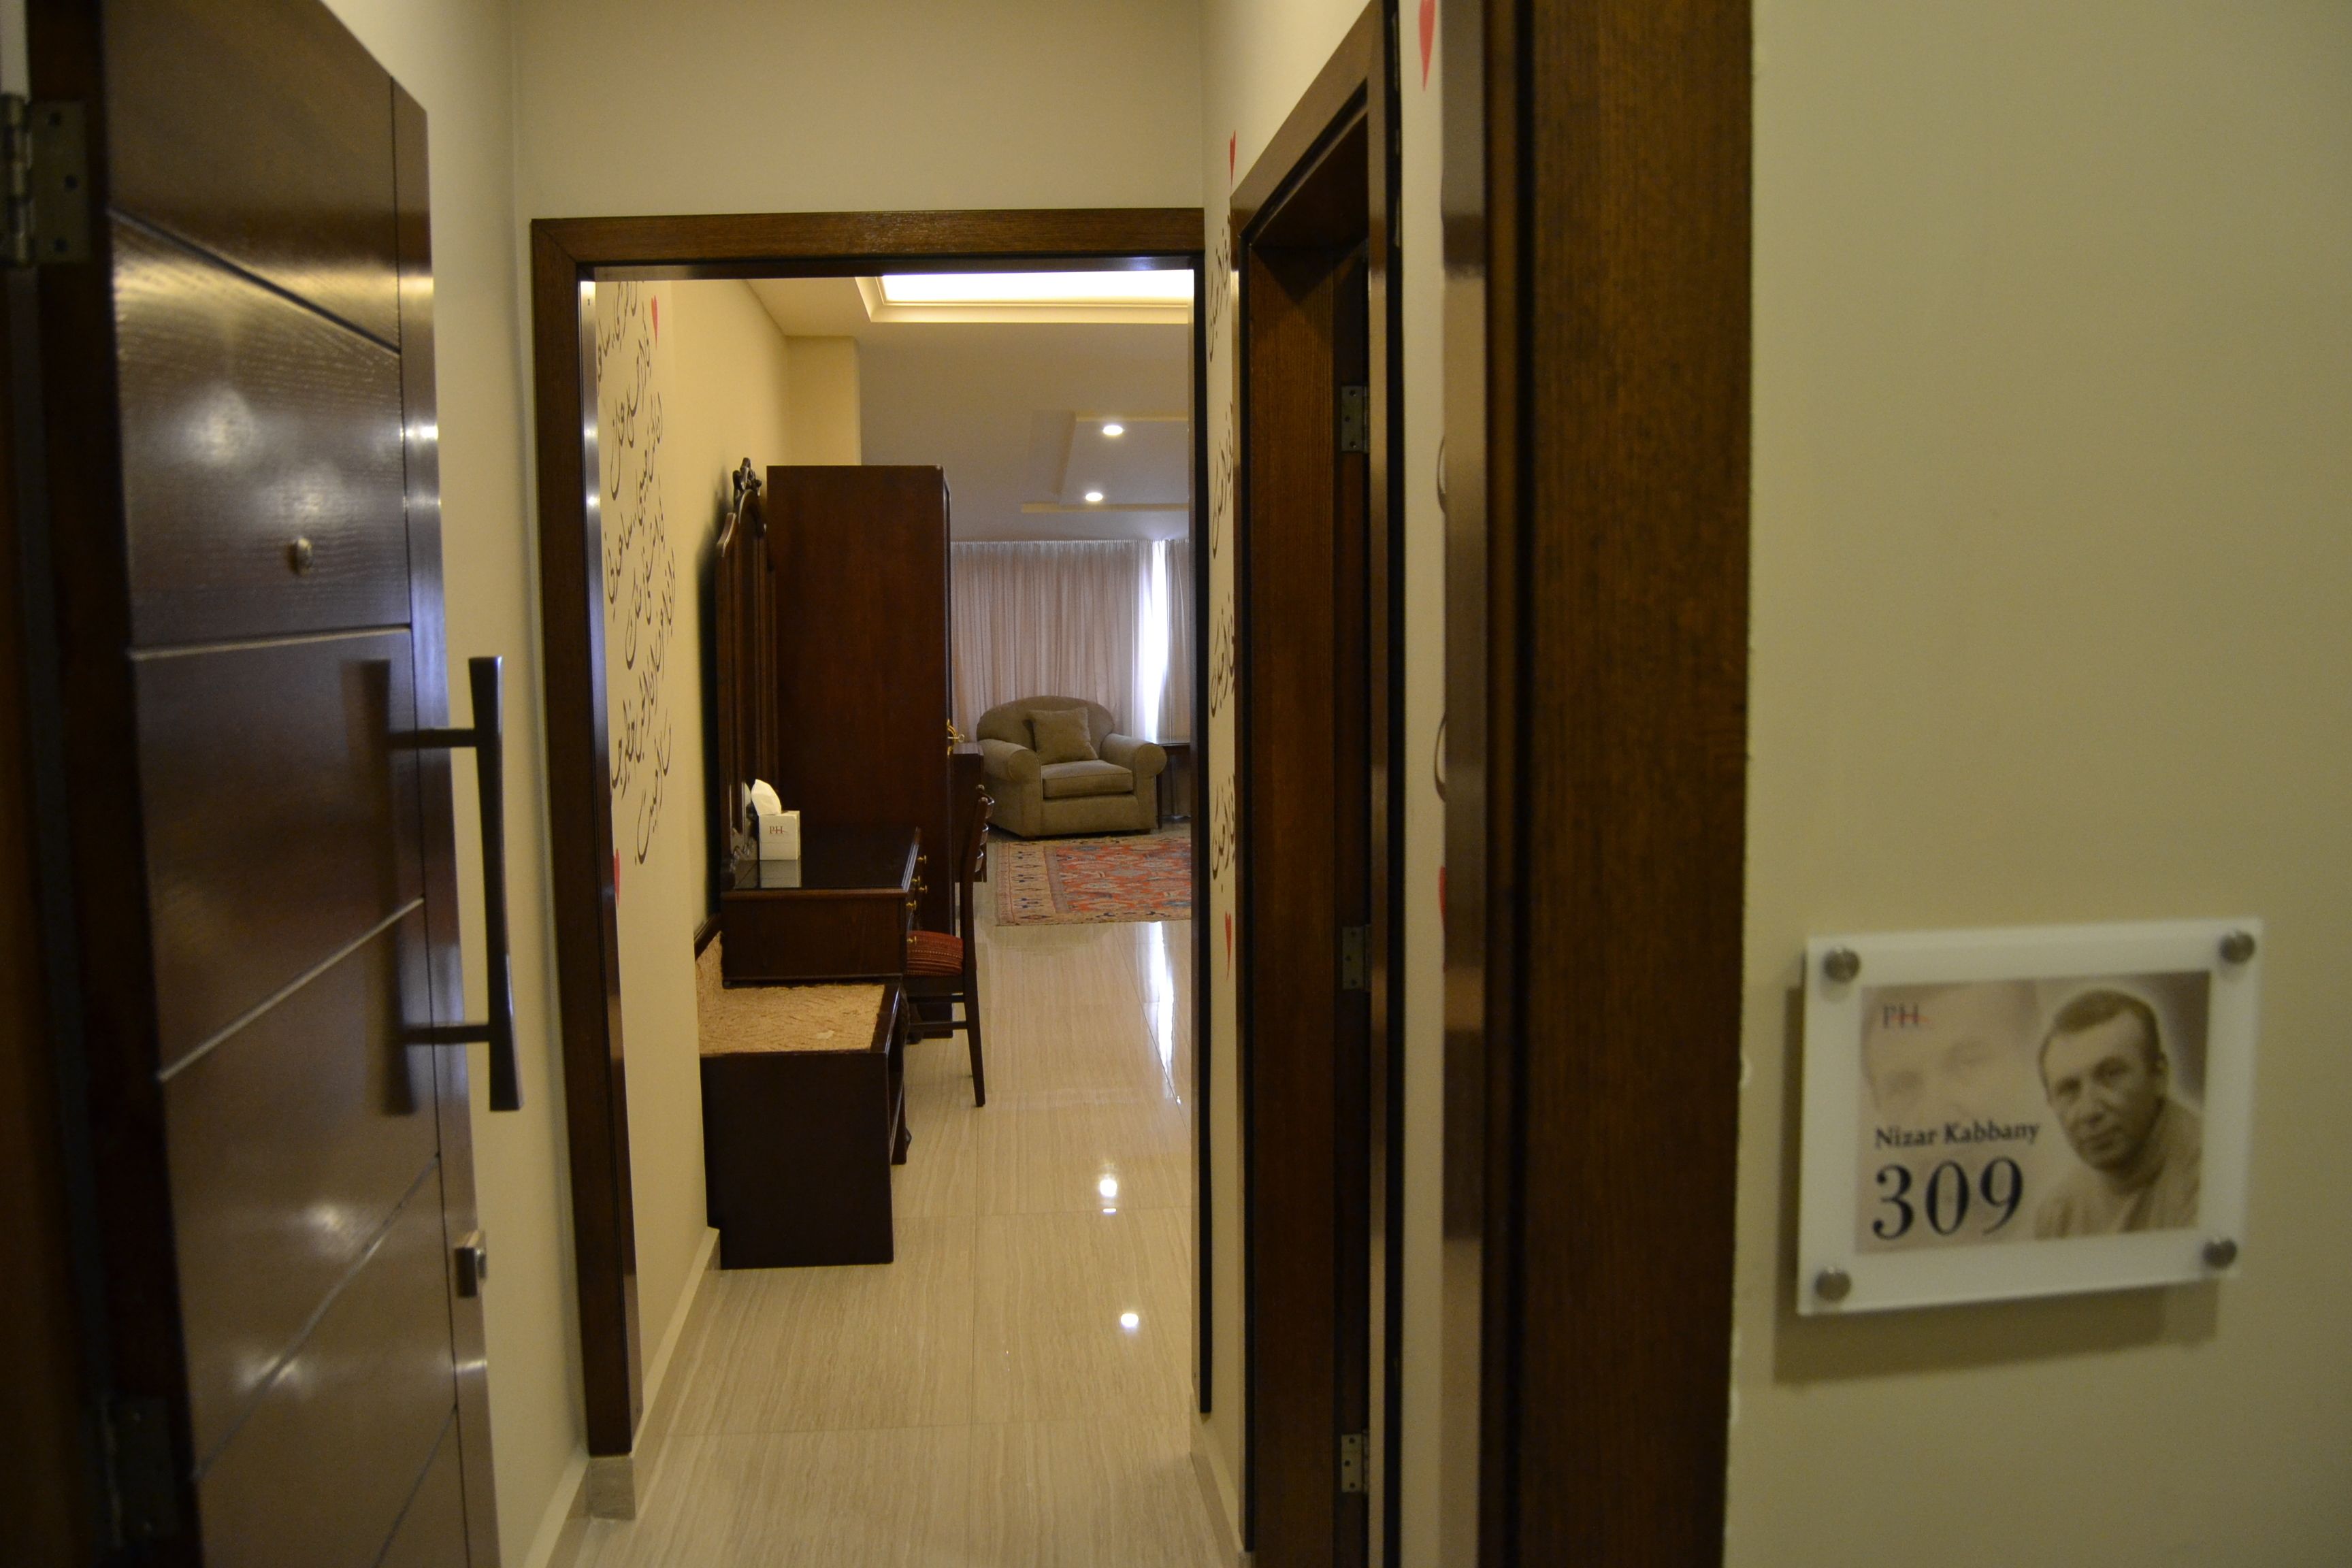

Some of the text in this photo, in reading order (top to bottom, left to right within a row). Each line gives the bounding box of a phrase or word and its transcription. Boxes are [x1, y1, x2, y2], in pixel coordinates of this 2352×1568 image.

[769, 826, 783, 834] PH
[1875, 1120, 2040, 1149] Nizar Kabbany
[1872, 1156, 2023, 1241] 309
